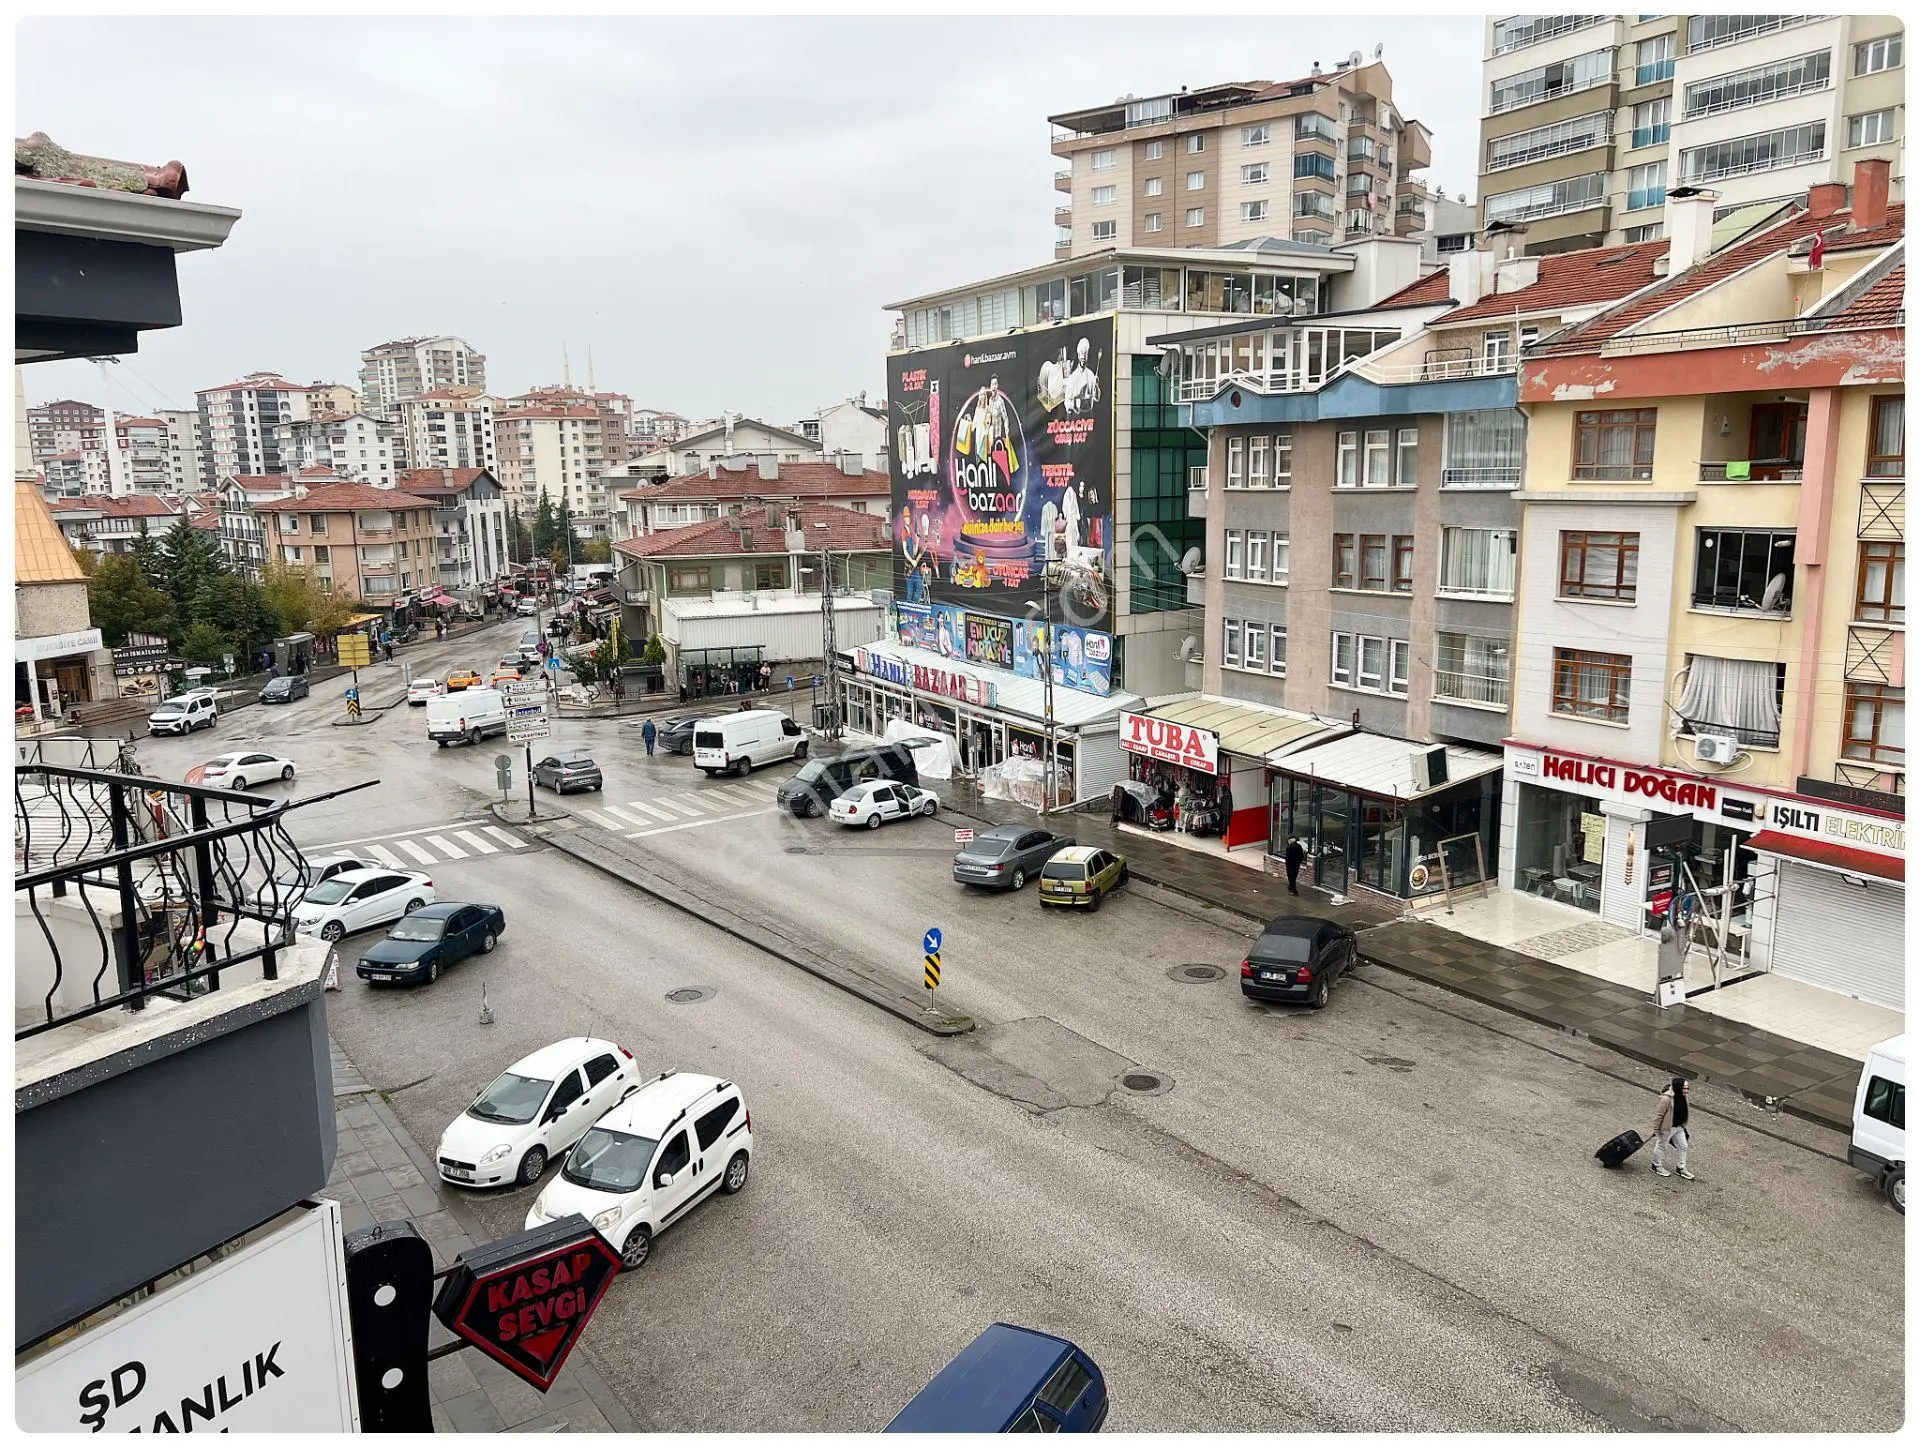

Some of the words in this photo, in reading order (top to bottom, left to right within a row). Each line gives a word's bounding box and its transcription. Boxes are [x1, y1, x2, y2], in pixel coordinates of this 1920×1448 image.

[1073, 432, 1087, 443] KAT
[968, 488, 1022, 512] bazaar
[1054, 476, 1070, 487] KAT
[992, 565, 1030, 579] OYUNCAK
[969, 622, 983, 639] EN
[982, 624, 1008, 645] UCUZ
[914, 663, 968, 702] BAZAAR
[1128, 715, 1206, 758] TUBA
[1543, 755, 1617, 789] HALICI
[1623, 771, 1717, 811] DOĞAN
[1773, 805, 1820, 833] IŞILTI
[488, 1253, 593, 1313] KASAP
[498, 1286, 586, 1342] SEVGİ
[79, 1360, 147, 1433] ŞD
[128, 1340, 286, 1433] ANLIK
